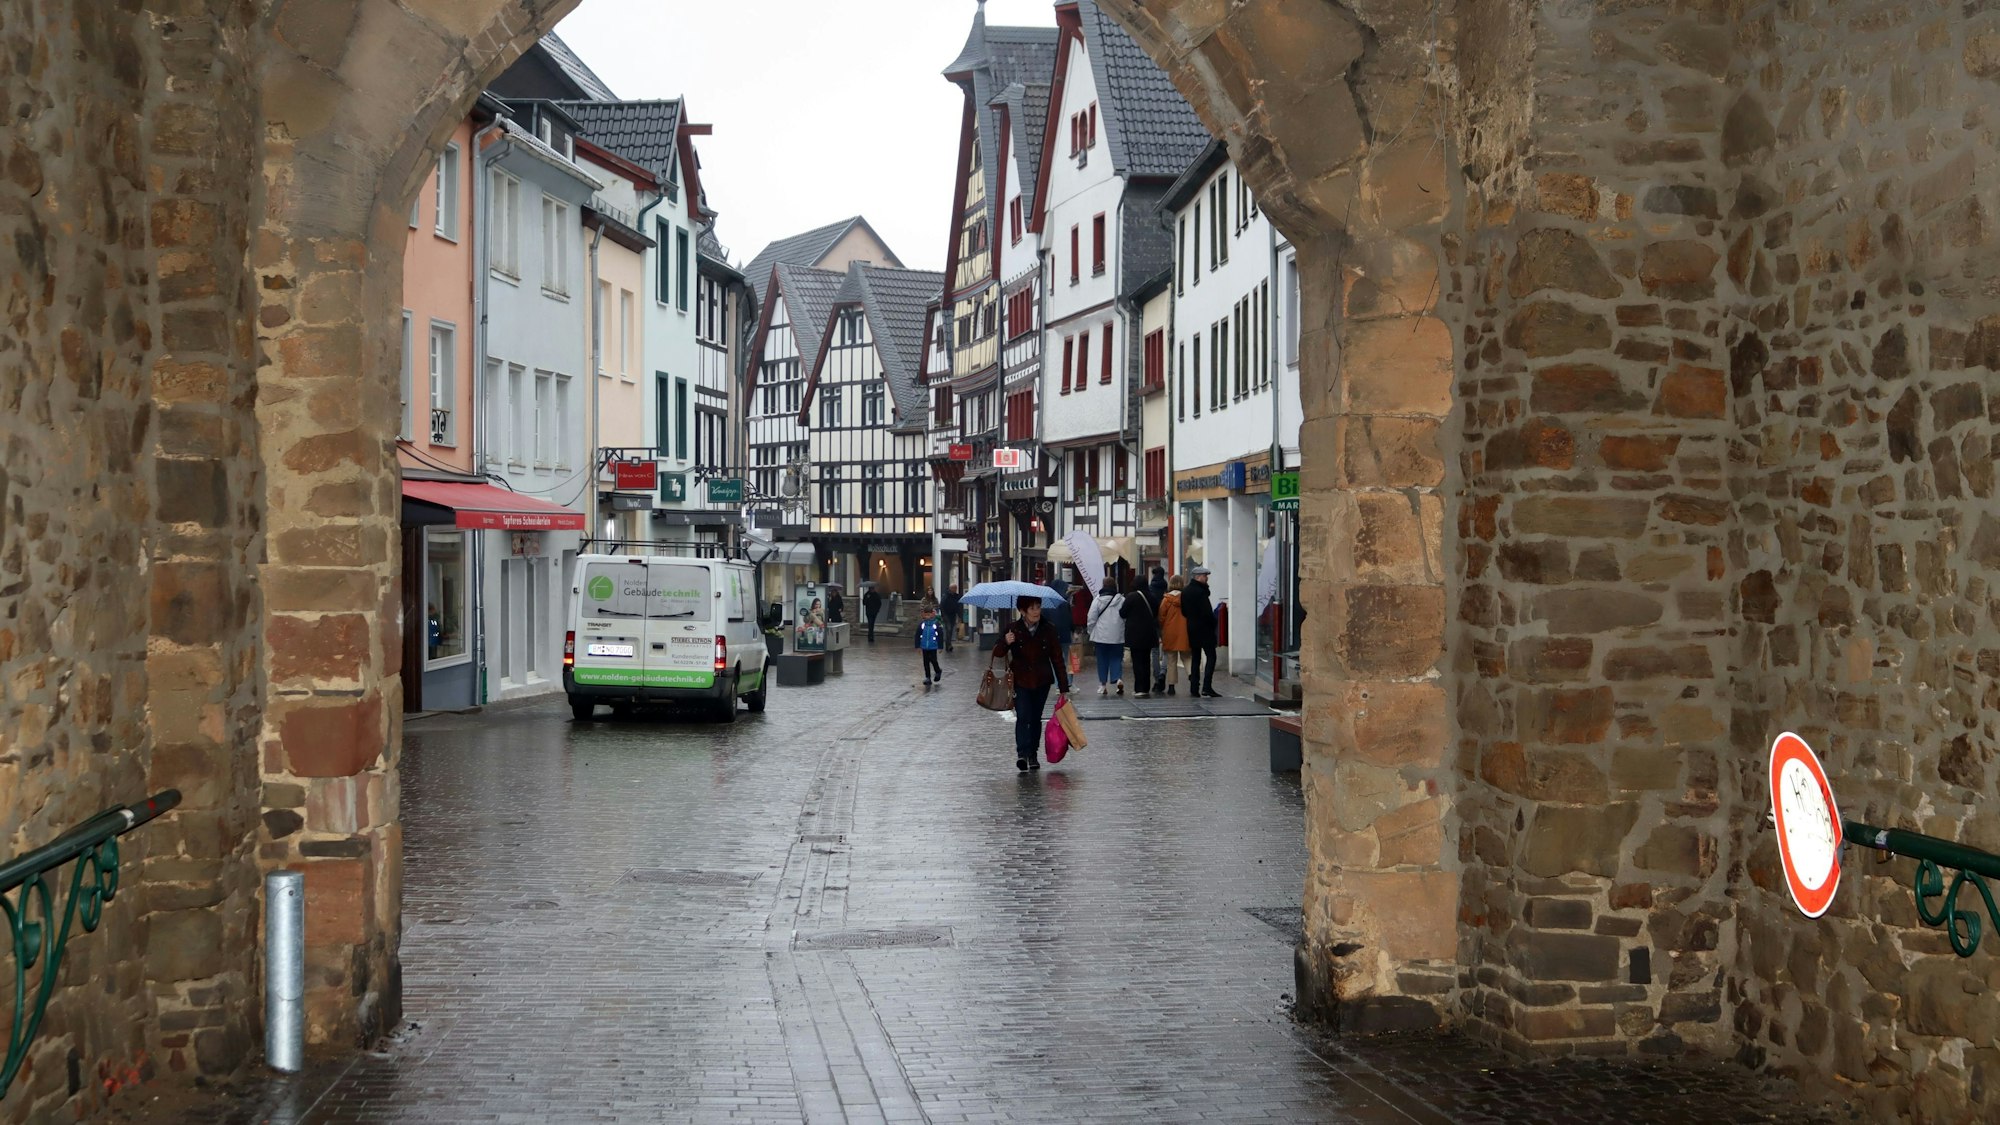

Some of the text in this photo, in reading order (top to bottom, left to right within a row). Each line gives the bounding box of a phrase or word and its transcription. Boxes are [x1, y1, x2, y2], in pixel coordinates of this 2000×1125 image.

[711, 486, 737, 498] Kneipp
[1278, 478, 1298, 495] Bi
[1278, 502, 1299, 510] MAR
[502, 514, 522, 528] Tapferes
[522, 515, 551, 526] Schneiderlein
[623, 587, 701, 598] Gebäudetechnik
